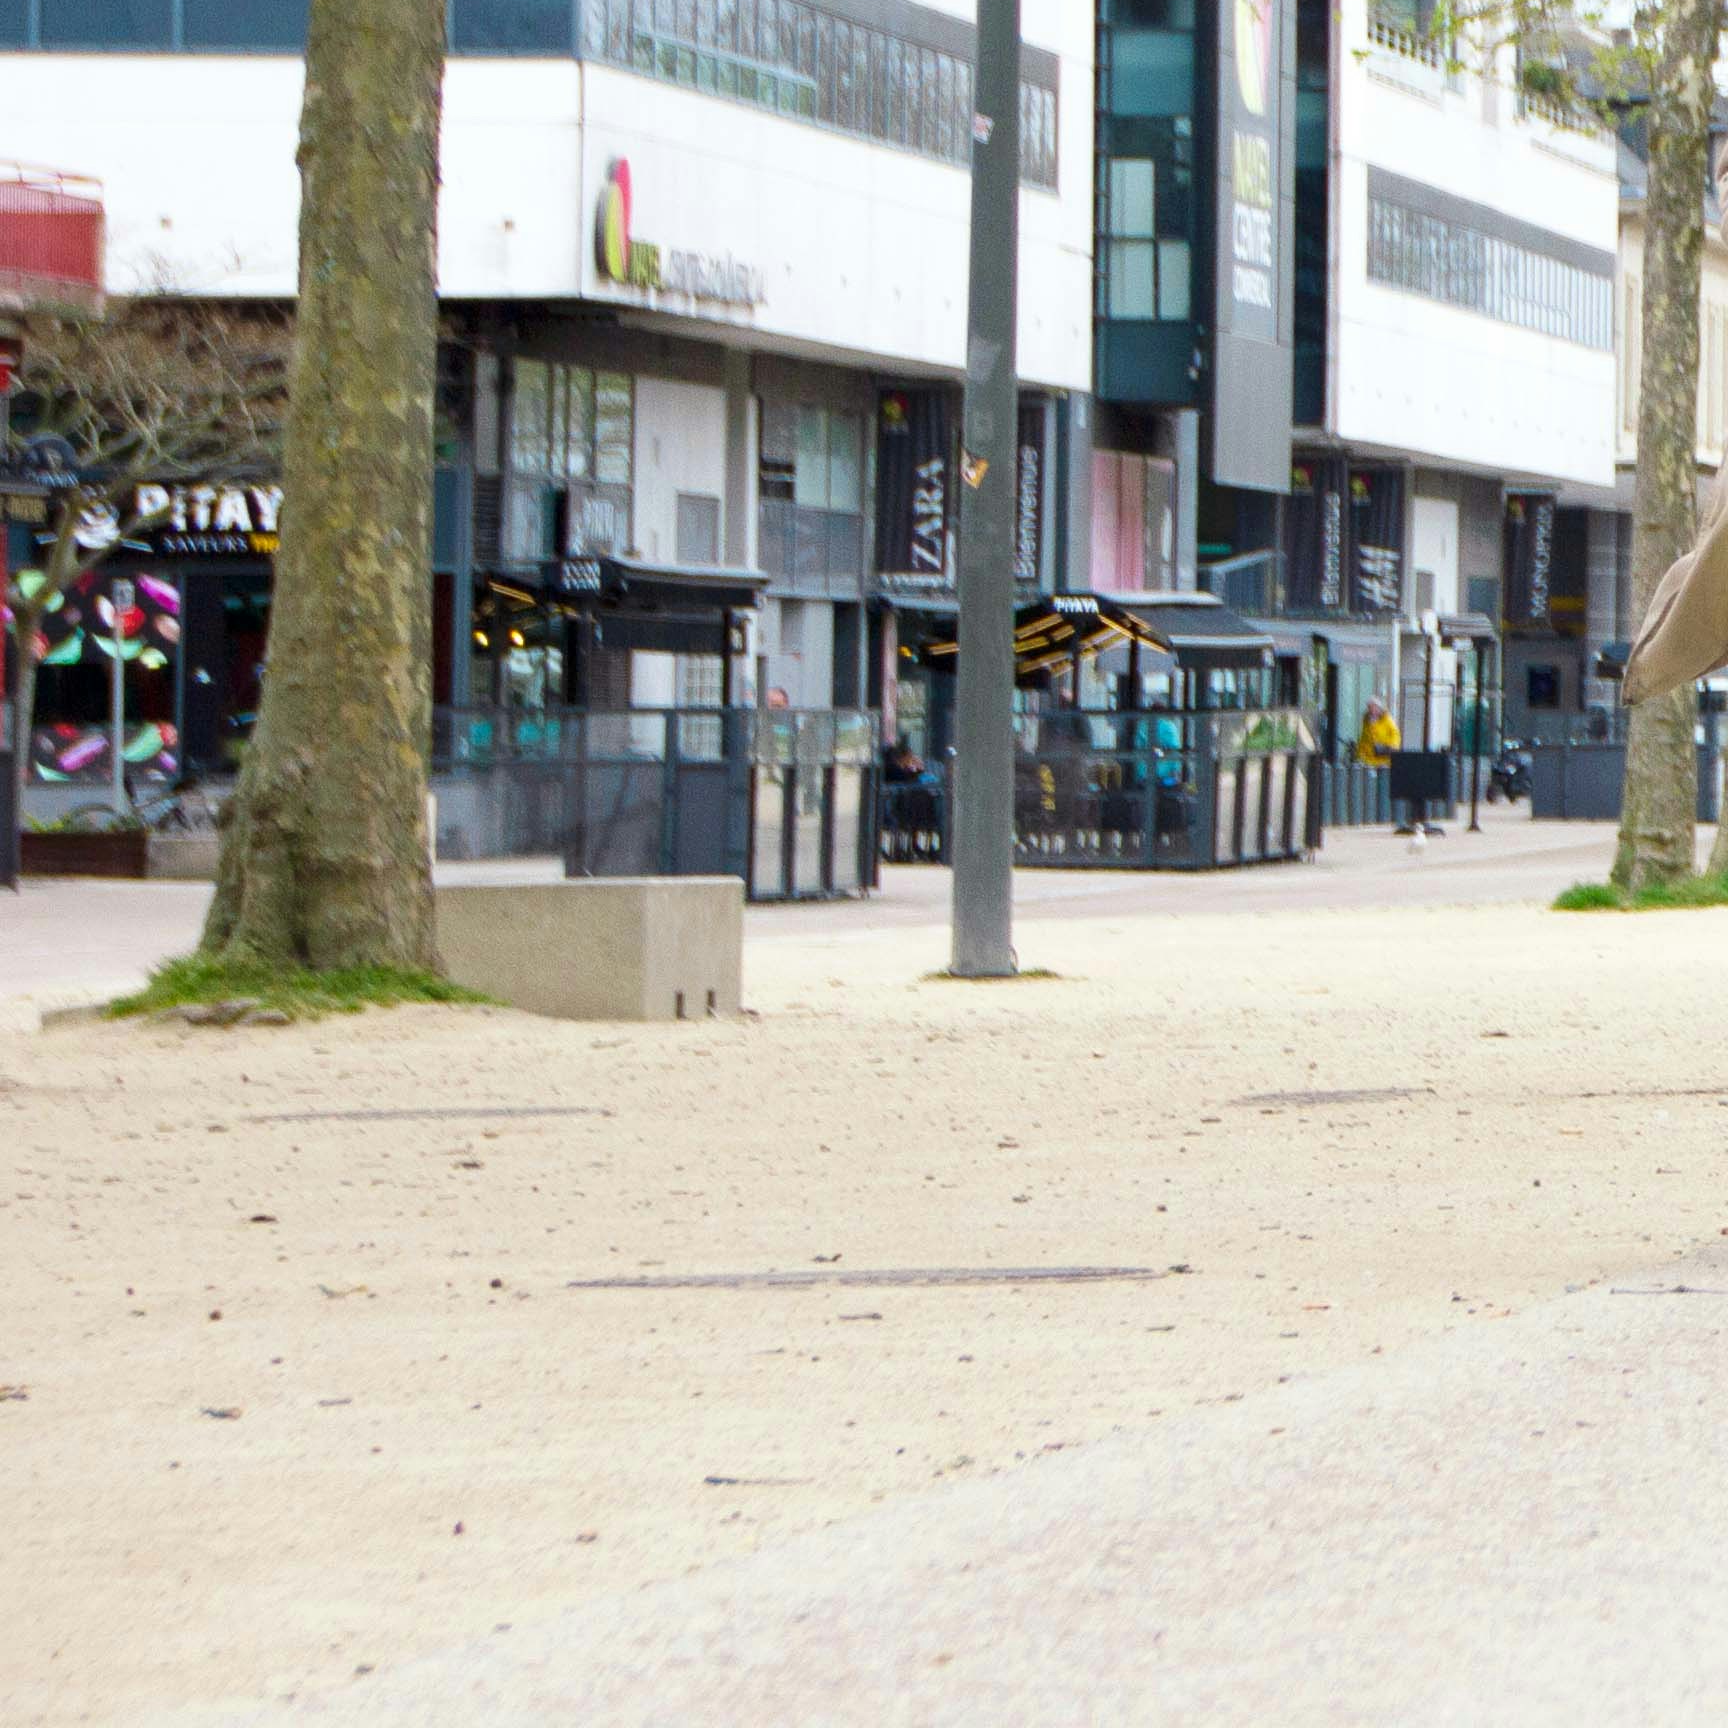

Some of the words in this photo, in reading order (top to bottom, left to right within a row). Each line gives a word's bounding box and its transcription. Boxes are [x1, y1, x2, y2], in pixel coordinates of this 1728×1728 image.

[136, 482, 285, 533] PITAY
[912, 457, 944, 569] ZARA
[1014, 445, 1039, 579] Bienvenue
